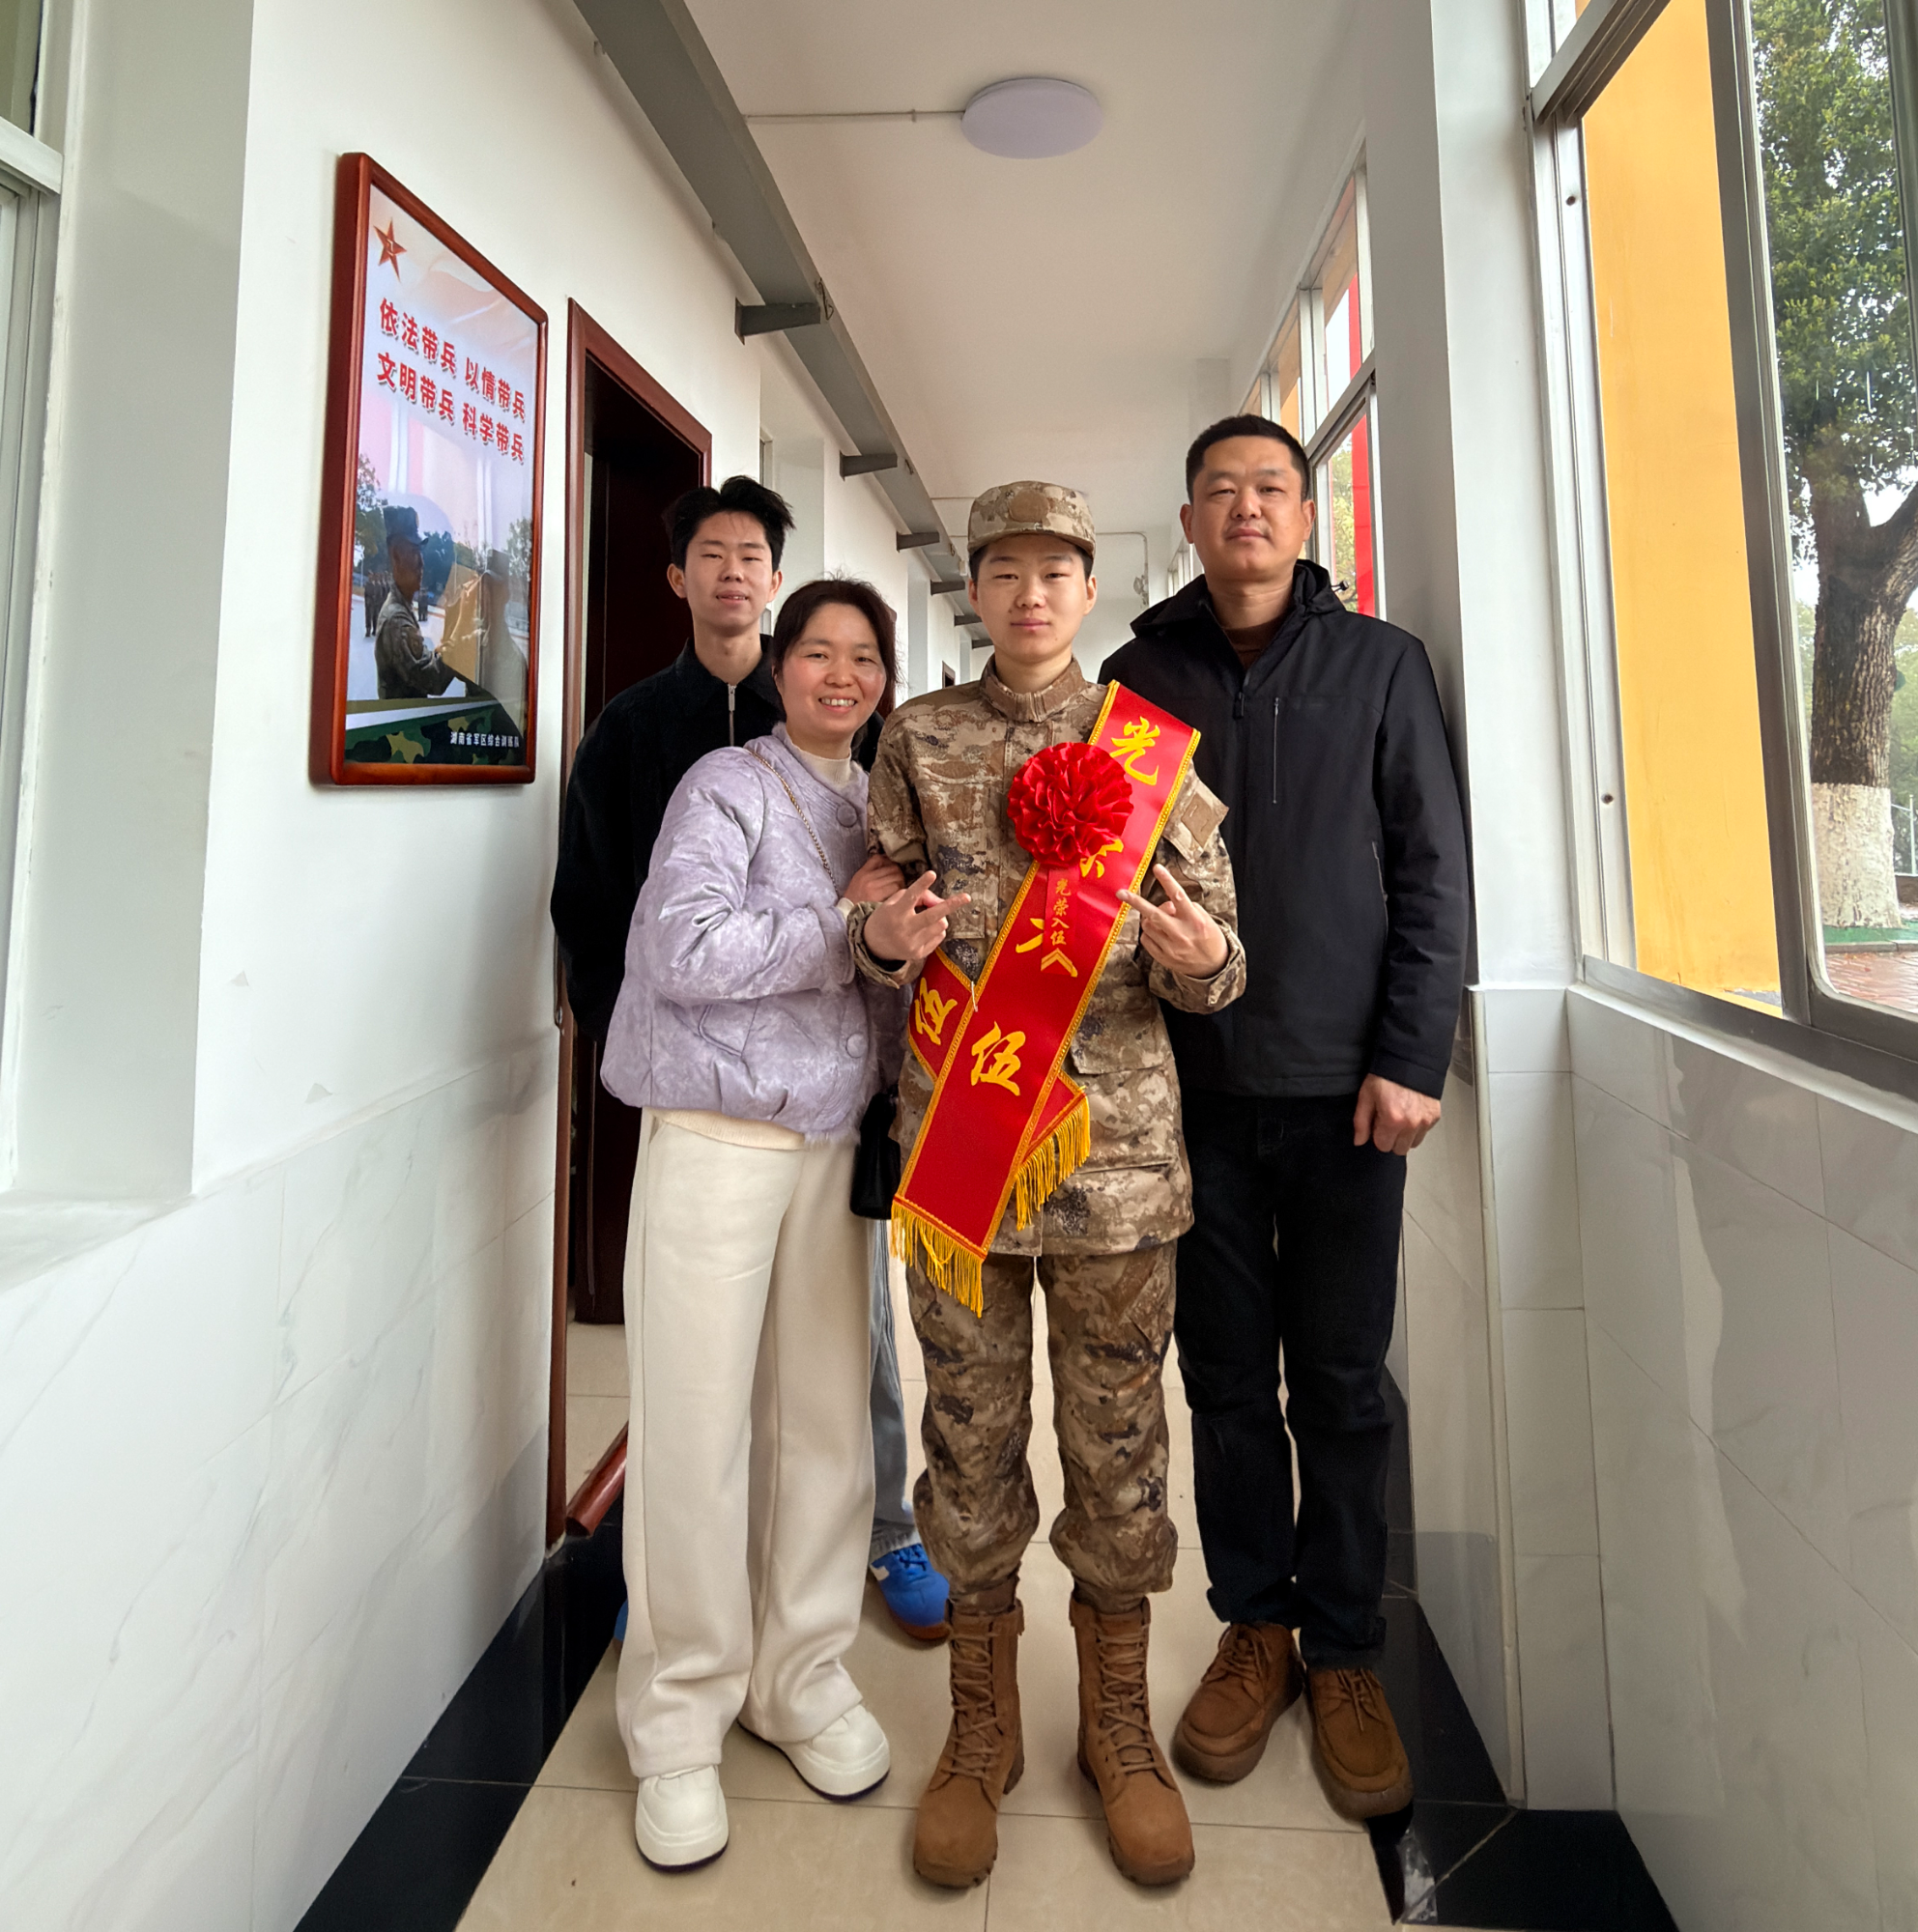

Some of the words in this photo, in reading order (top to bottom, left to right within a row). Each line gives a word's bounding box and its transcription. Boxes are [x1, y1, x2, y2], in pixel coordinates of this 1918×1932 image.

[377, 352, 454, 423] 文明带兵
[462, 402, 524, 463] 科学带兵
[379, 297, 456, 376] 依法带兵
[465, 356, 525, 422] 以情带兵
[1050, 877, 1072, 946] 光荣入伍
